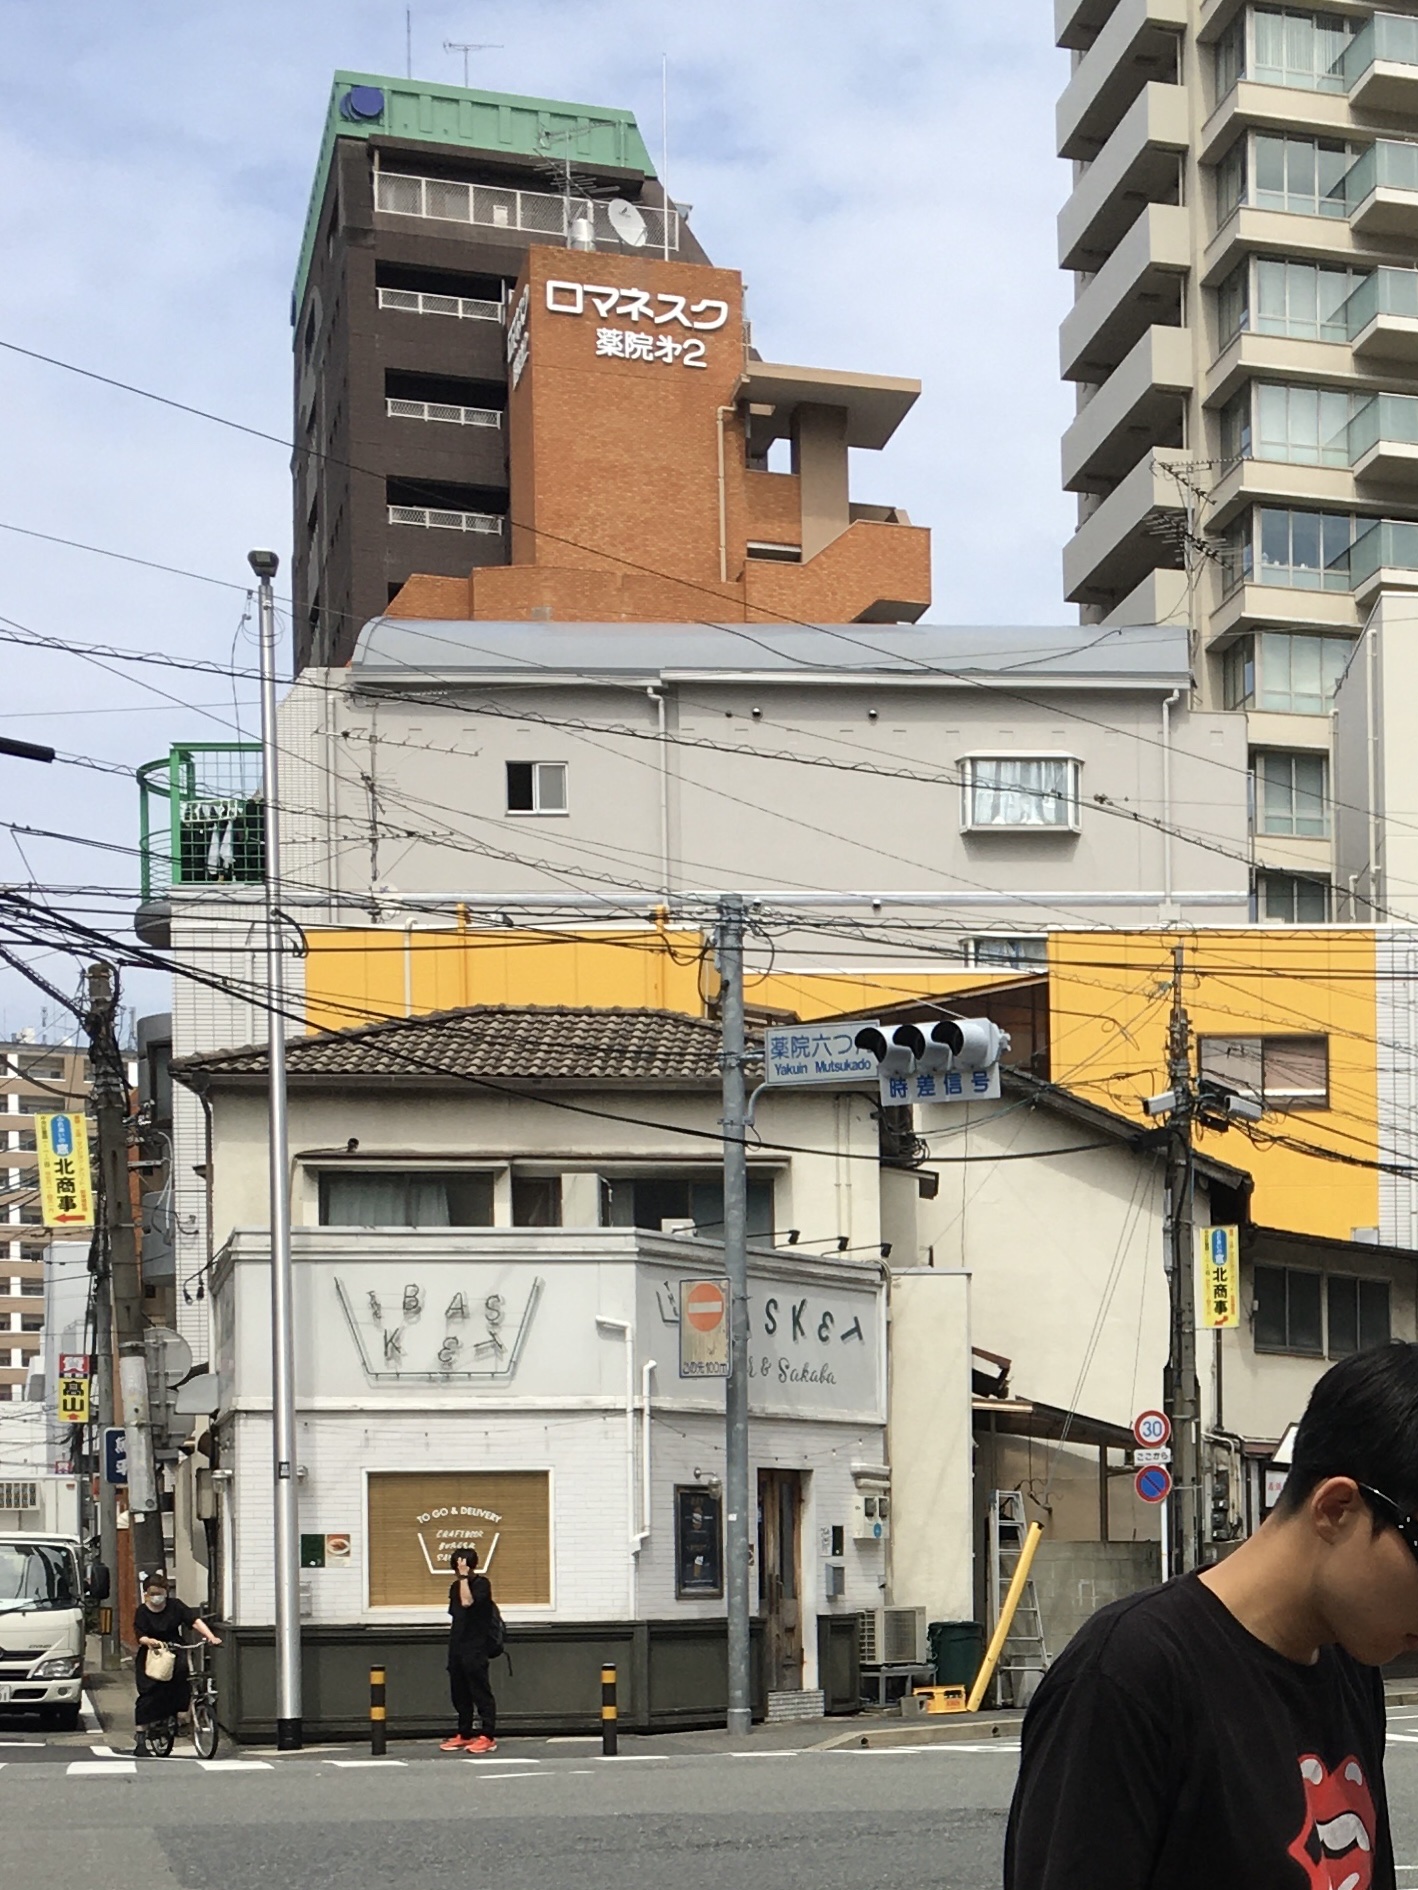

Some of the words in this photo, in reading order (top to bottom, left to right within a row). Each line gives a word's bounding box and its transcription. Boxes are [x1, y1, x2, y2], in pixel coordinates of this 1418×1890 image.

[546, 279, 729, 331] ロマネスク
[770, 1032, 874, 1061] 薬院六つ
[774, 1058, 808, 1076] Yakuin
[815, 1060, 872, 1073] Mutsukado
[889, 1072, 990, 1099] 時差信号
[54, 1158, 77, 1212] 北商事
[1213, 1267, 1228, 1315] 北商事
[778, 1358, 837, 1385] Sakaba
[1142, 1420, 1163, 1438] 30
[1137, 1452, 1168, 1461] ここから
[417, 1513, 431, 1524] TO
[432, 1507, 449, 1519] GO
[460, 1506, 502, 1523] DELIVERY
